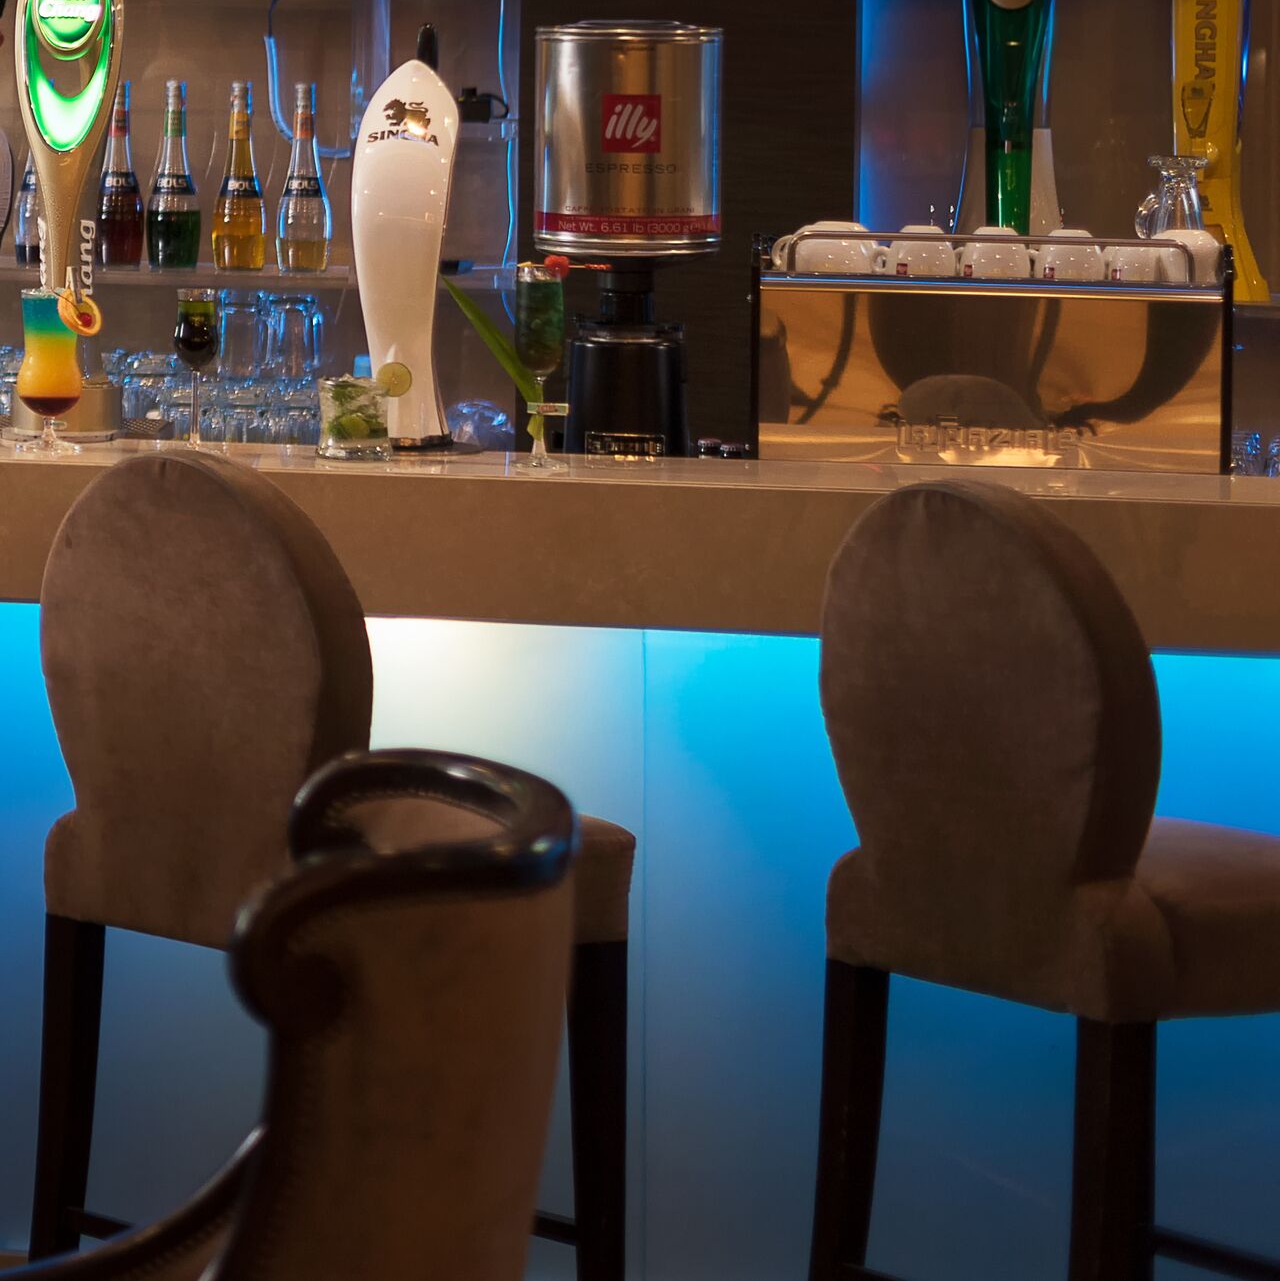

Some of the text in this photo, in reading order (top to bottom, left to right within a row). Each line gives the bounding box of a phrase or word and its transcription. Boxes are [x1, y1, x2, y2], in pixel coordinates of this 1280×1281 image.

[605, 103, 658, 149] illy
[366, 129, 439, 147] SINA
[584, 163, 678, 175] ESPRESSO
[156, 176, 188, 188] BOLS
[287, 179, 319, 191] BOLS
[558, 220, 576, 231] Net
[579, 221, 597, 232] Wt.
[601, 223, 628, 233] 6.61
[632, 223, 644, 233] lb
